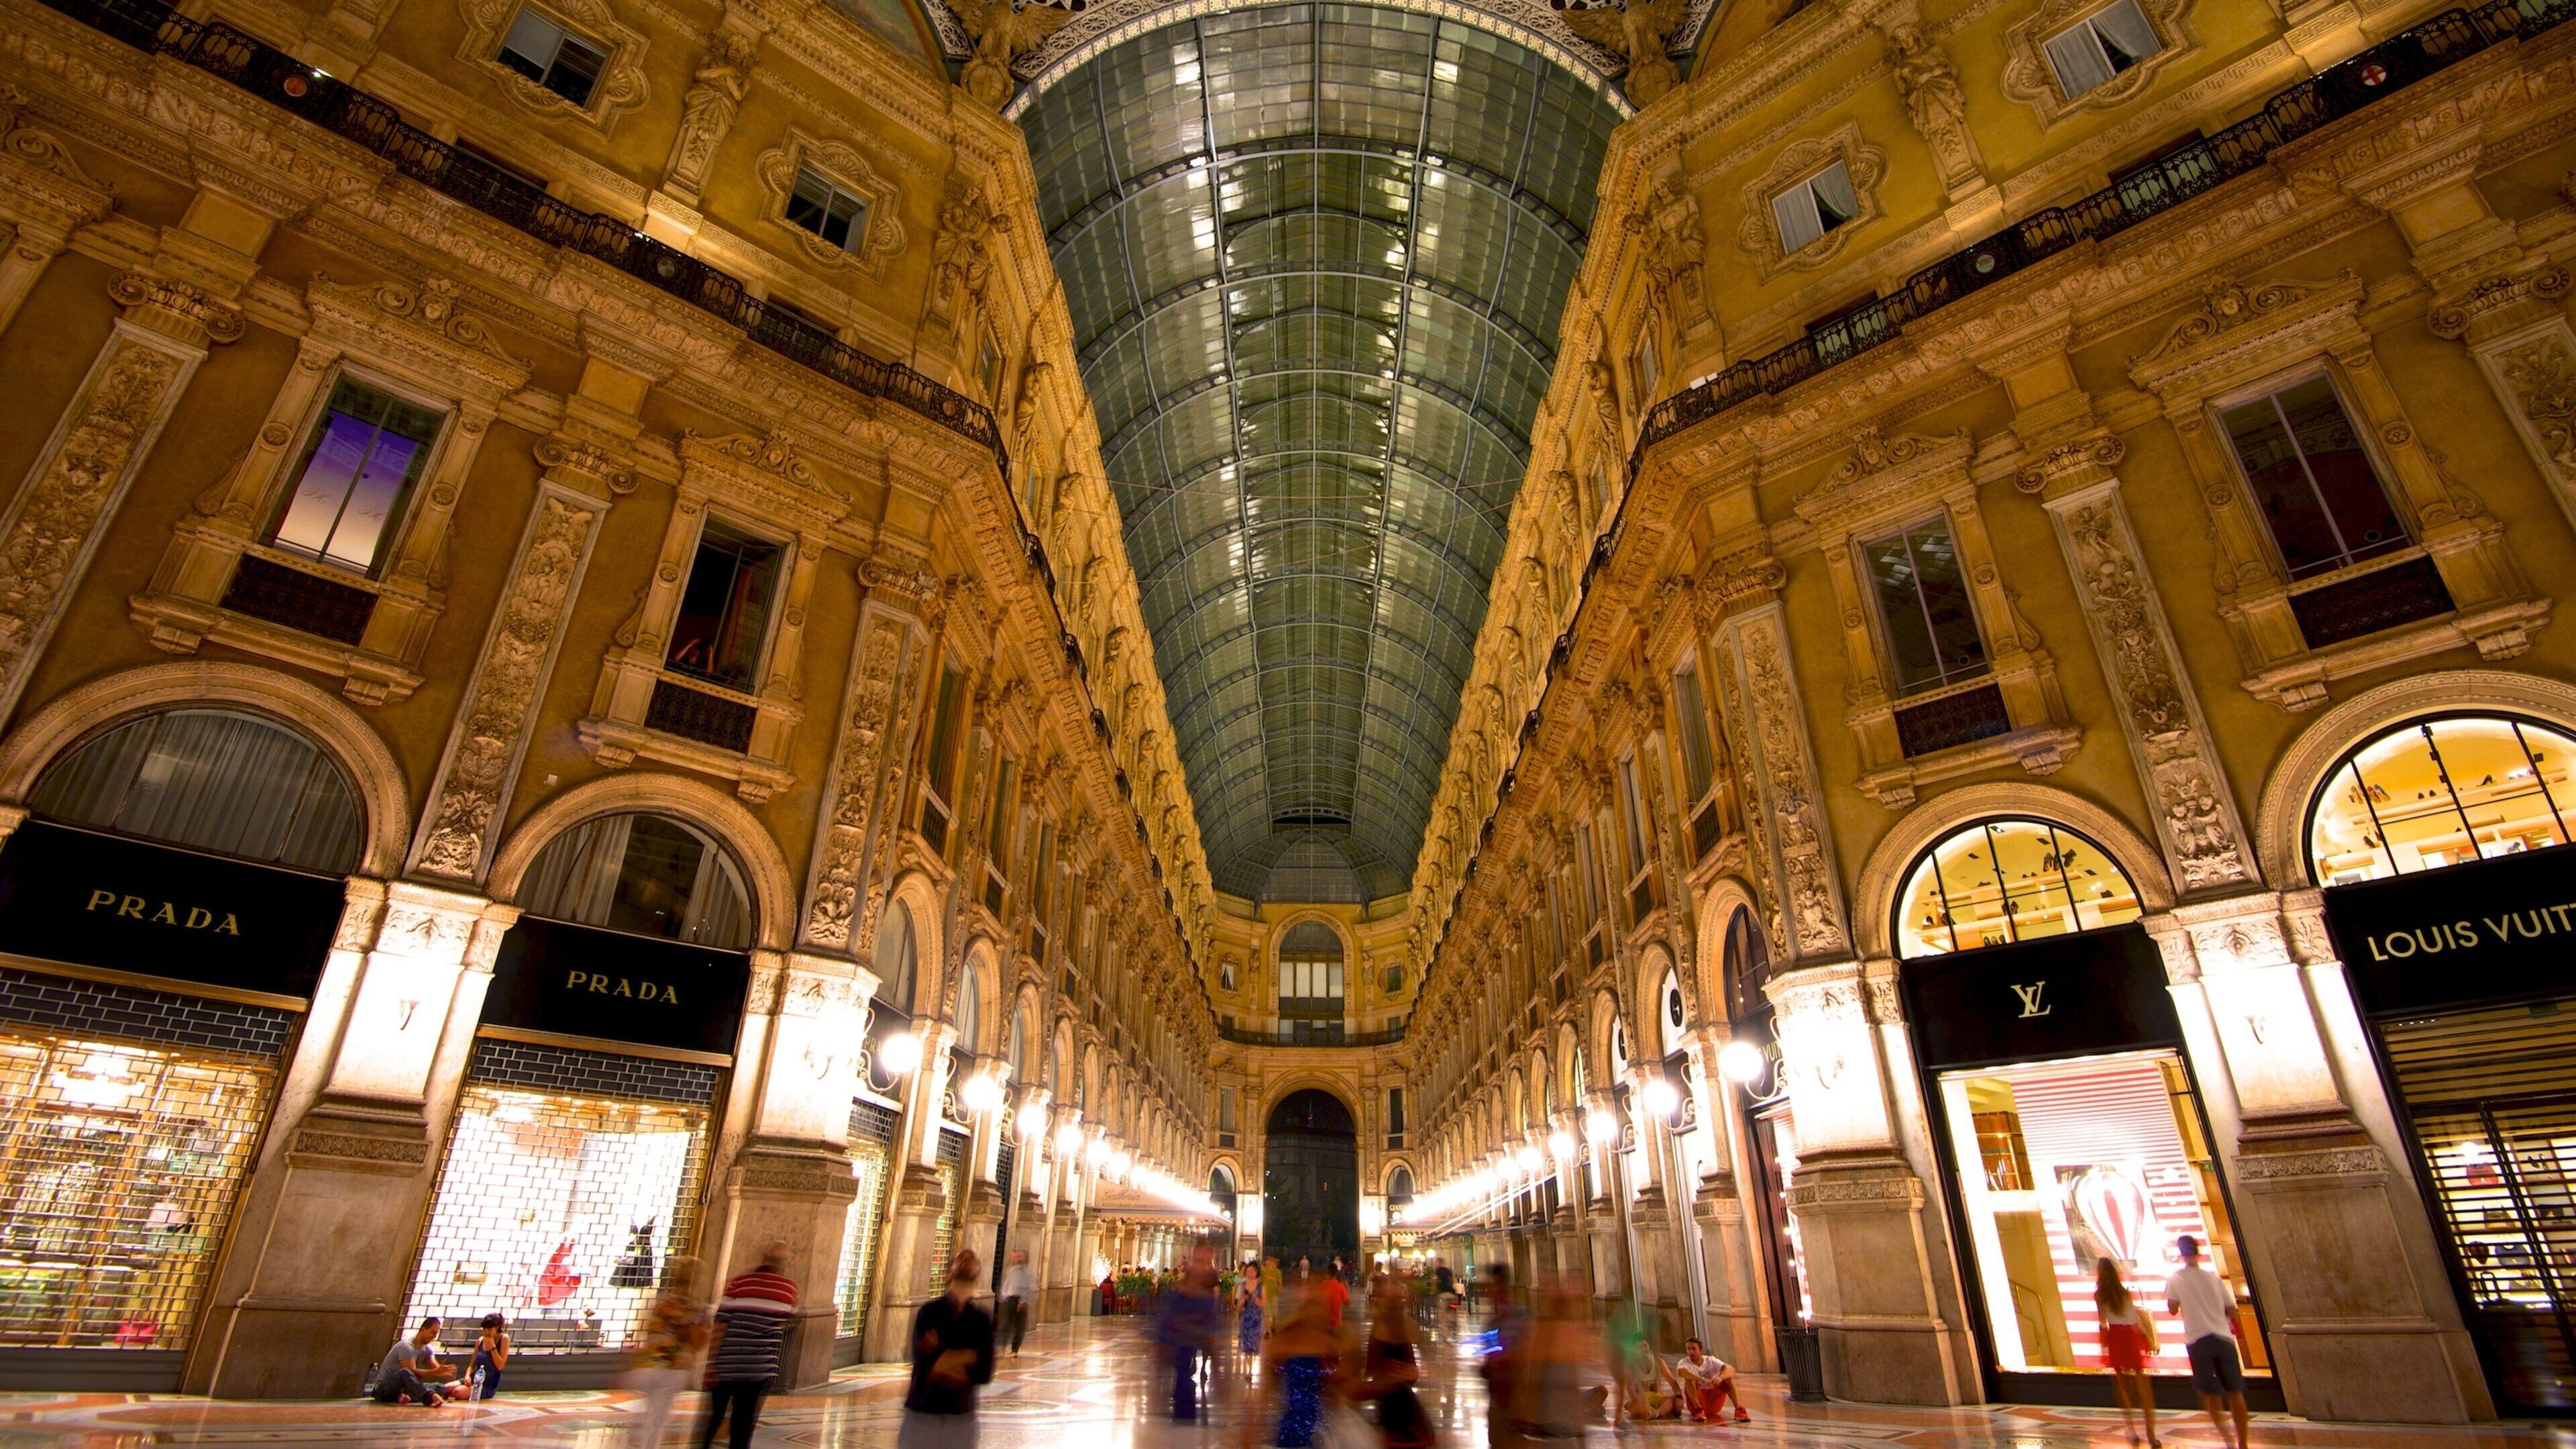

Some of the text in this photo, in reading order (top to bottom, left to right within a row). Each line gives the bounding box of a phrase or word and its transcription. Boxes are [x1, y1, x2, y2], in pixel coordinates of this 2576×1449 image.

[86, 890, 241, 936] PRADA
[2367, 903, 2576, 961] LOUIS VUIT
[566, 970, 679, 1005] PRADA
[1102, 1188, 1141, 1201] Galleria
